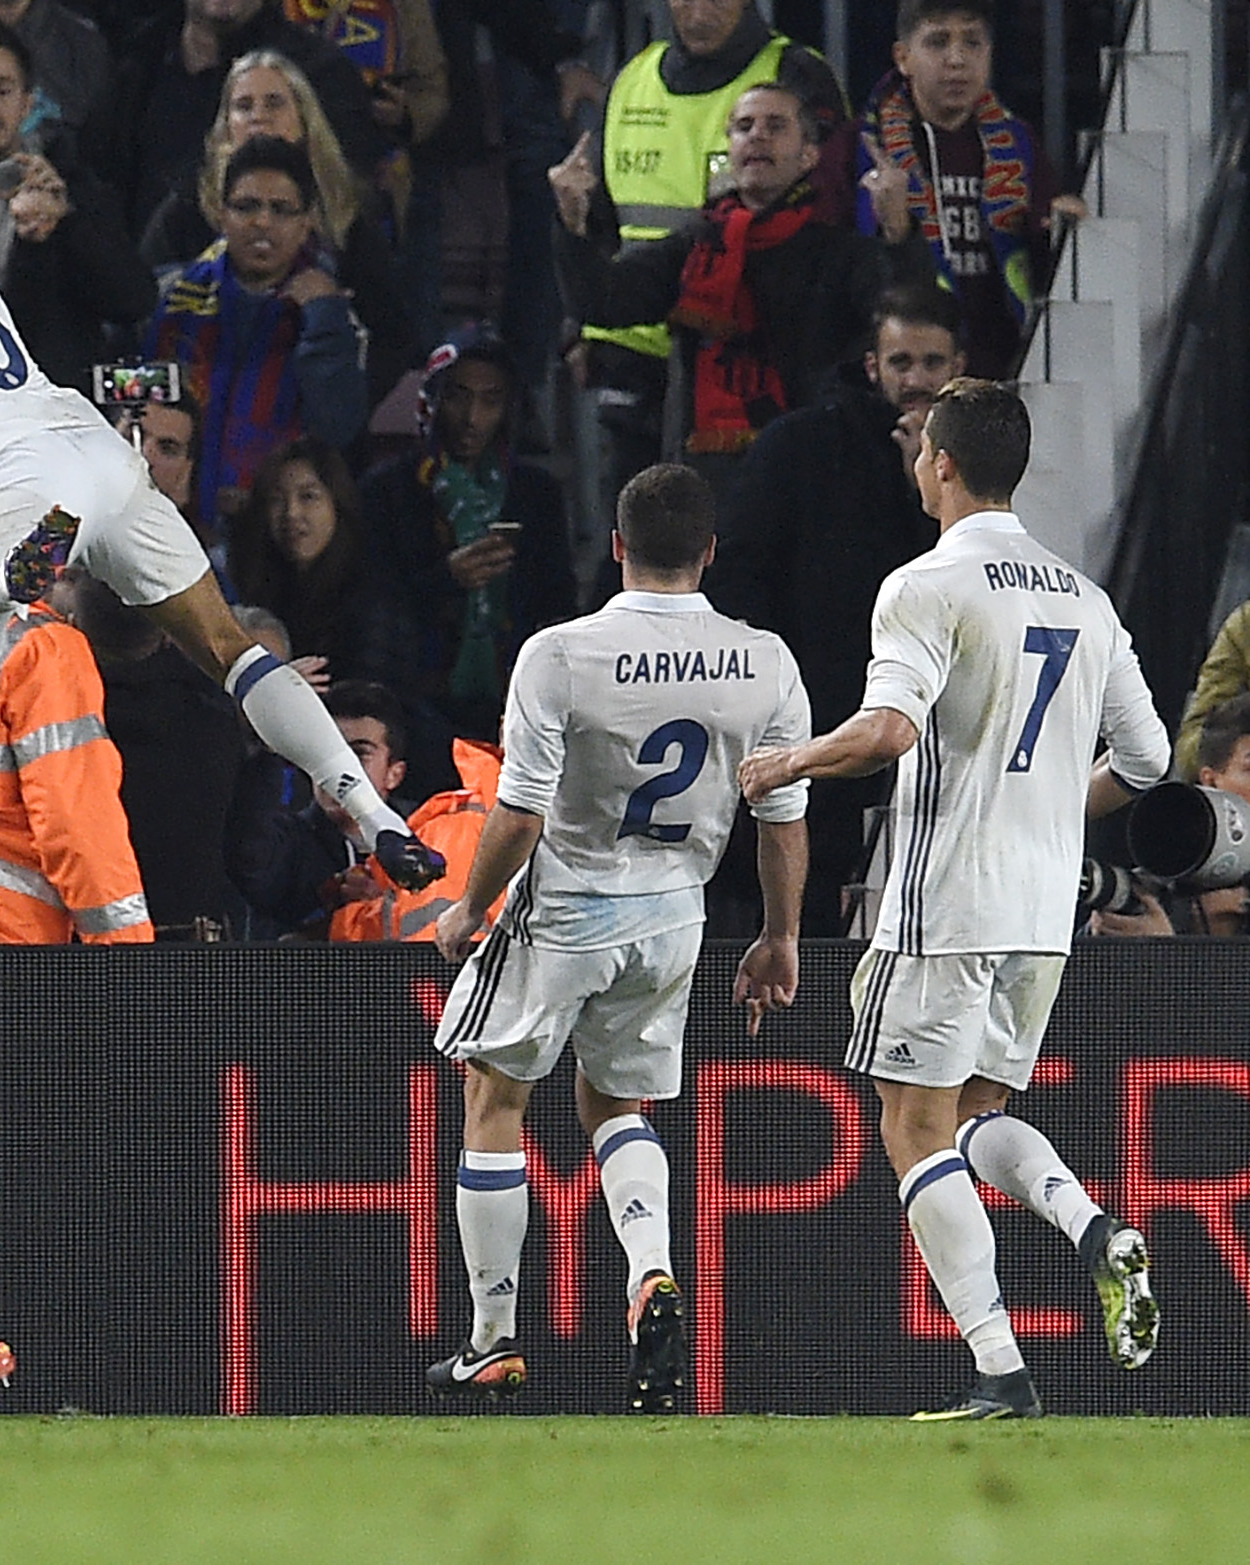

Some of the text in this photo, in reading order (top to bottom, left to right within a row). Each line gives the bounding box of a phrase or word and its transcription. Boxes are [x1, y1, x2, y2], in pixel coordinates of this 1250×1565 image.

[983, 560, 1081, 598] RONALDO
[615, 648, 756, 685] CARVAJAL
[1005, 625, 1082, 774] 7
[616, 718, 710, 843] 2
